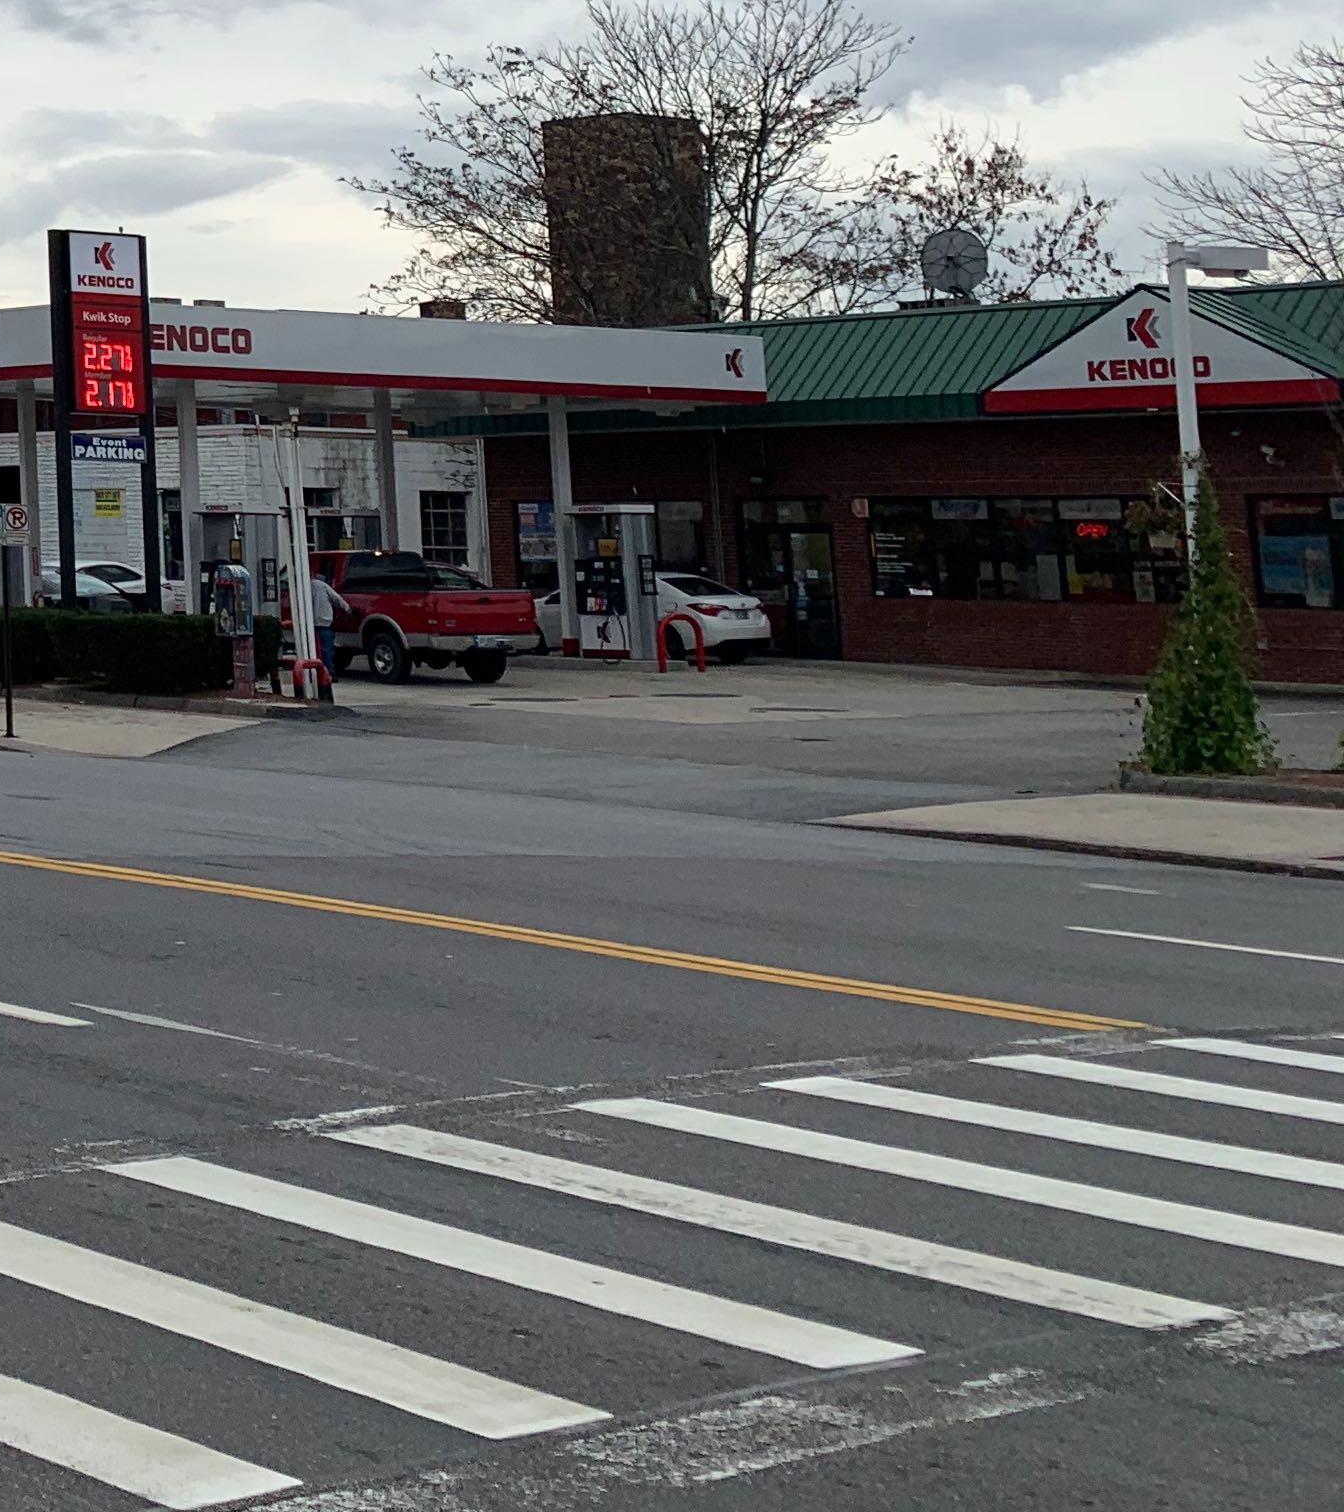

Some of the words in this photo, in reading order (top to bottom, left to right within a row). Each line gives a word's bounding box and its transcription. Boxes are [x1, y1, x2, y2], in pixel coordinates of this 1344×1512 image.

[77, 274, 134, 289] KENOCO
[83, 311, 107, 323] Kwik
[109, 313, 132, 326] Stop
[150, 324, 253, 354] ENOCO
[93, 438, 127, 447] Event
[74, 444, 145, 461] PARKING
